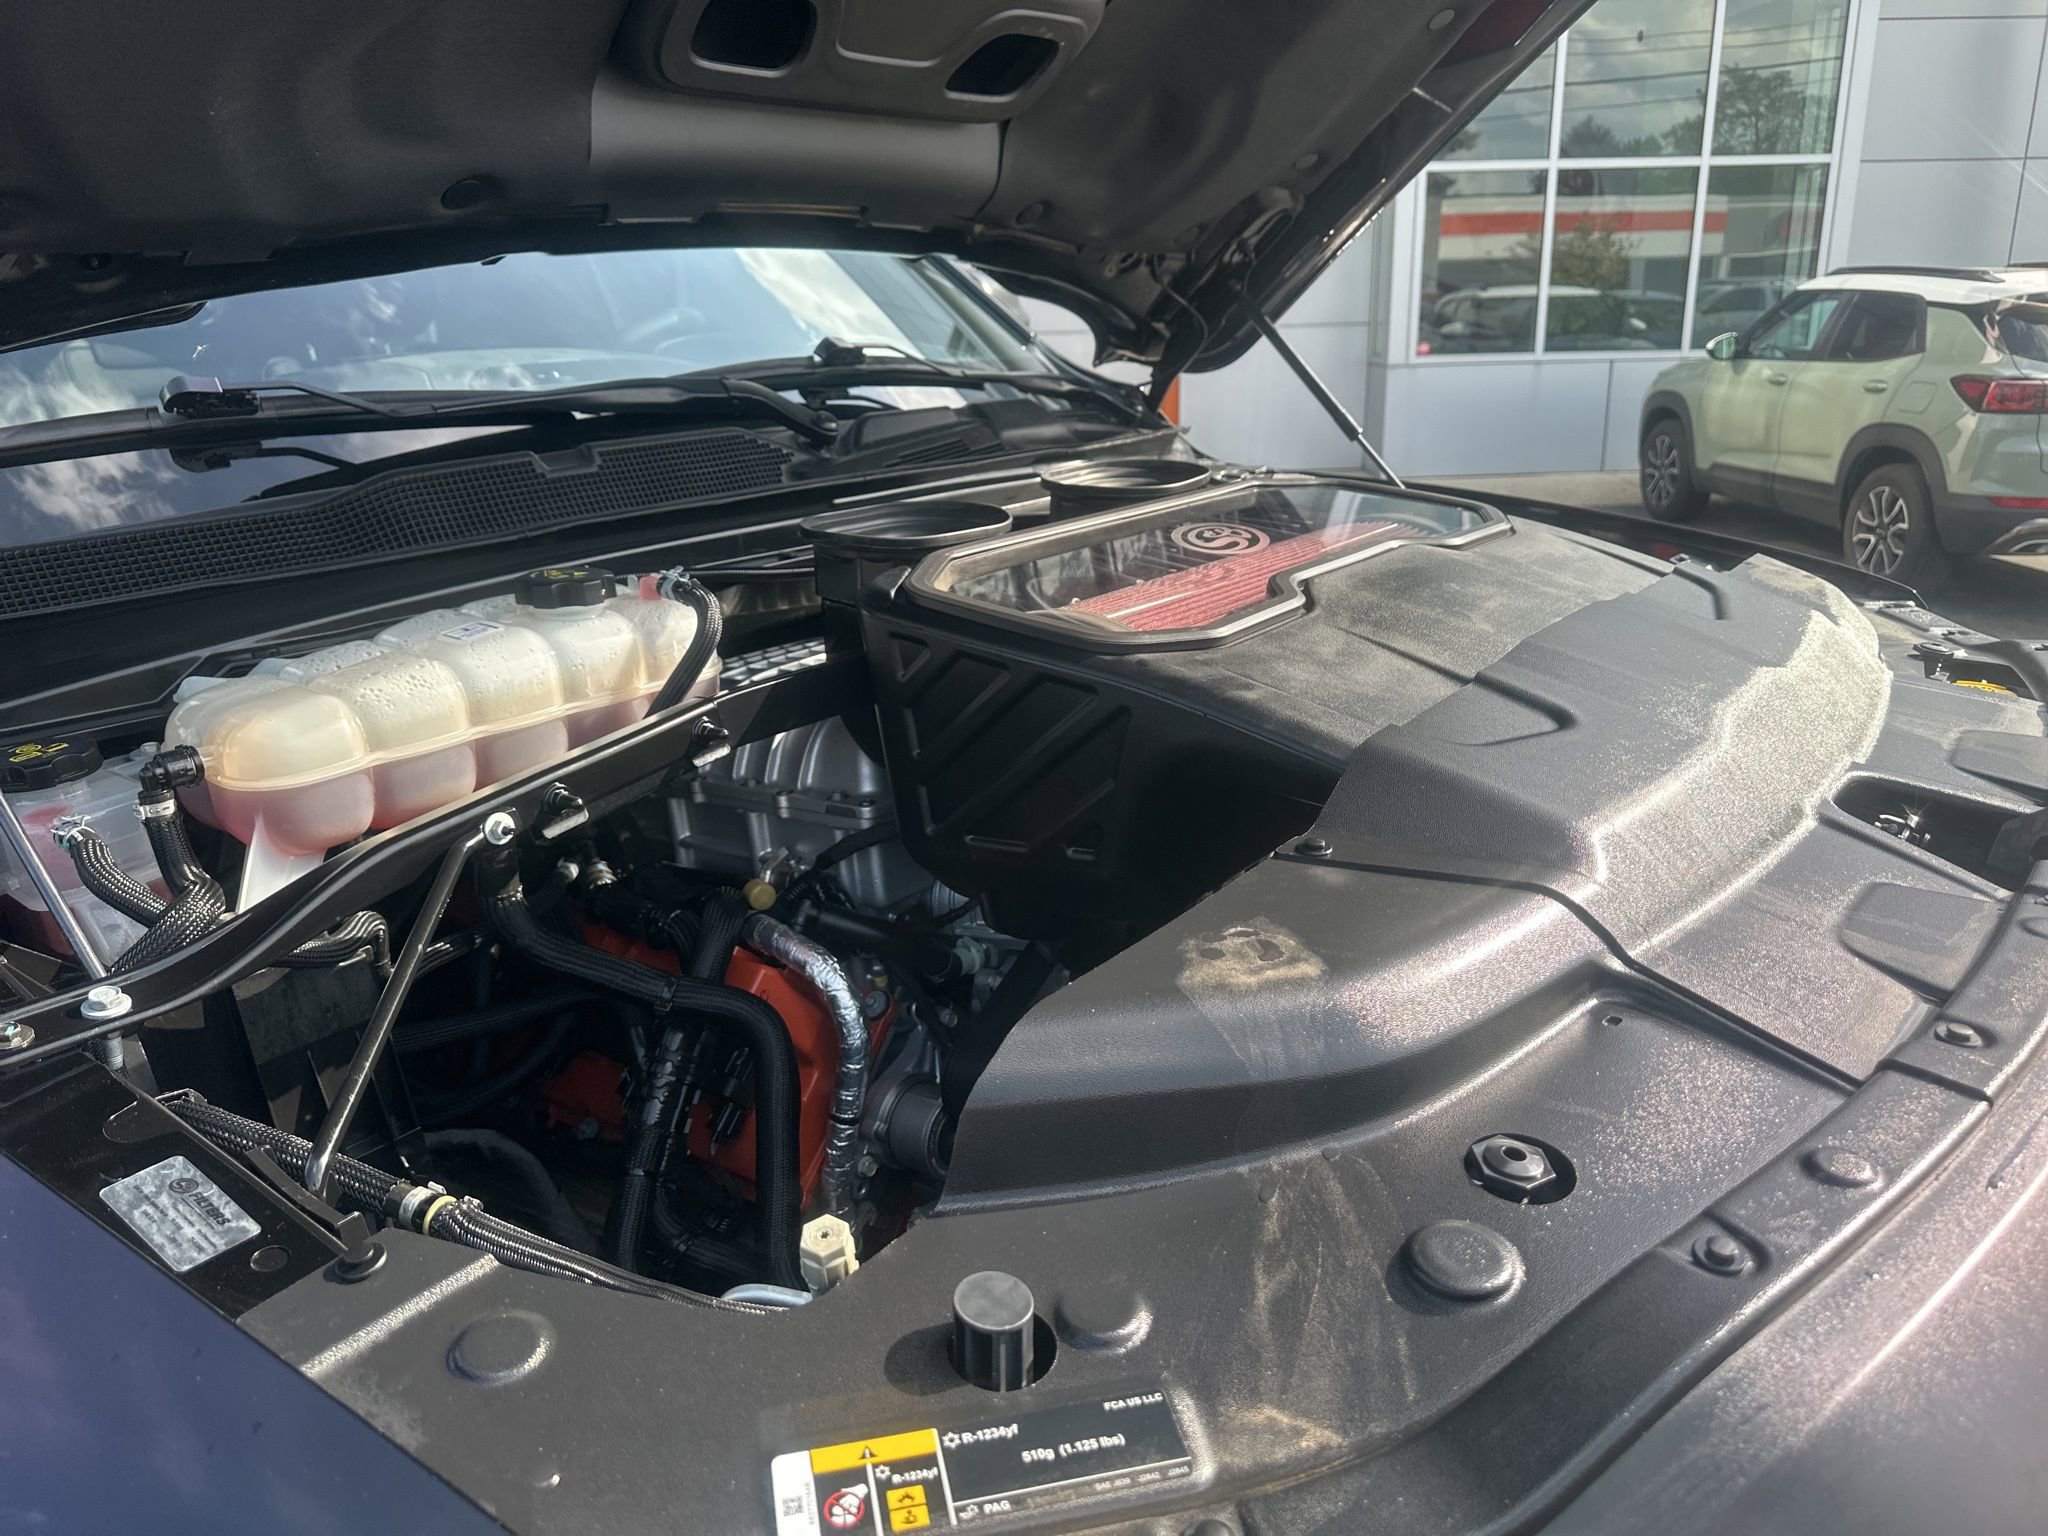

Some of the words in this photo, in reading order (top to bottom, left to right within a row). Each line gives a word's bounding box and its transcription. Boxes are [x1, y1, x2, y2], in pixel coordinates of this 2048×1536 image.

[188, 1191, 231, 1226] FILTERS
[1103, 1396, 1126, 1411] FCA
[1127, 1395, 1142, 1407] US
[1143, 1391, 1163, 1404] LLC
[961, 1423, 1019, 1444] R-1234yf
[1021, 1447, 1055, 1463] 510g
[1058, 1437, 1098, 1457] (1.125
[1100, 1432, 1126, 1449] lbs)
[891, 1466, 939, 1484] R-1234yf
[982, 1500, 1011, 1515] PAG
